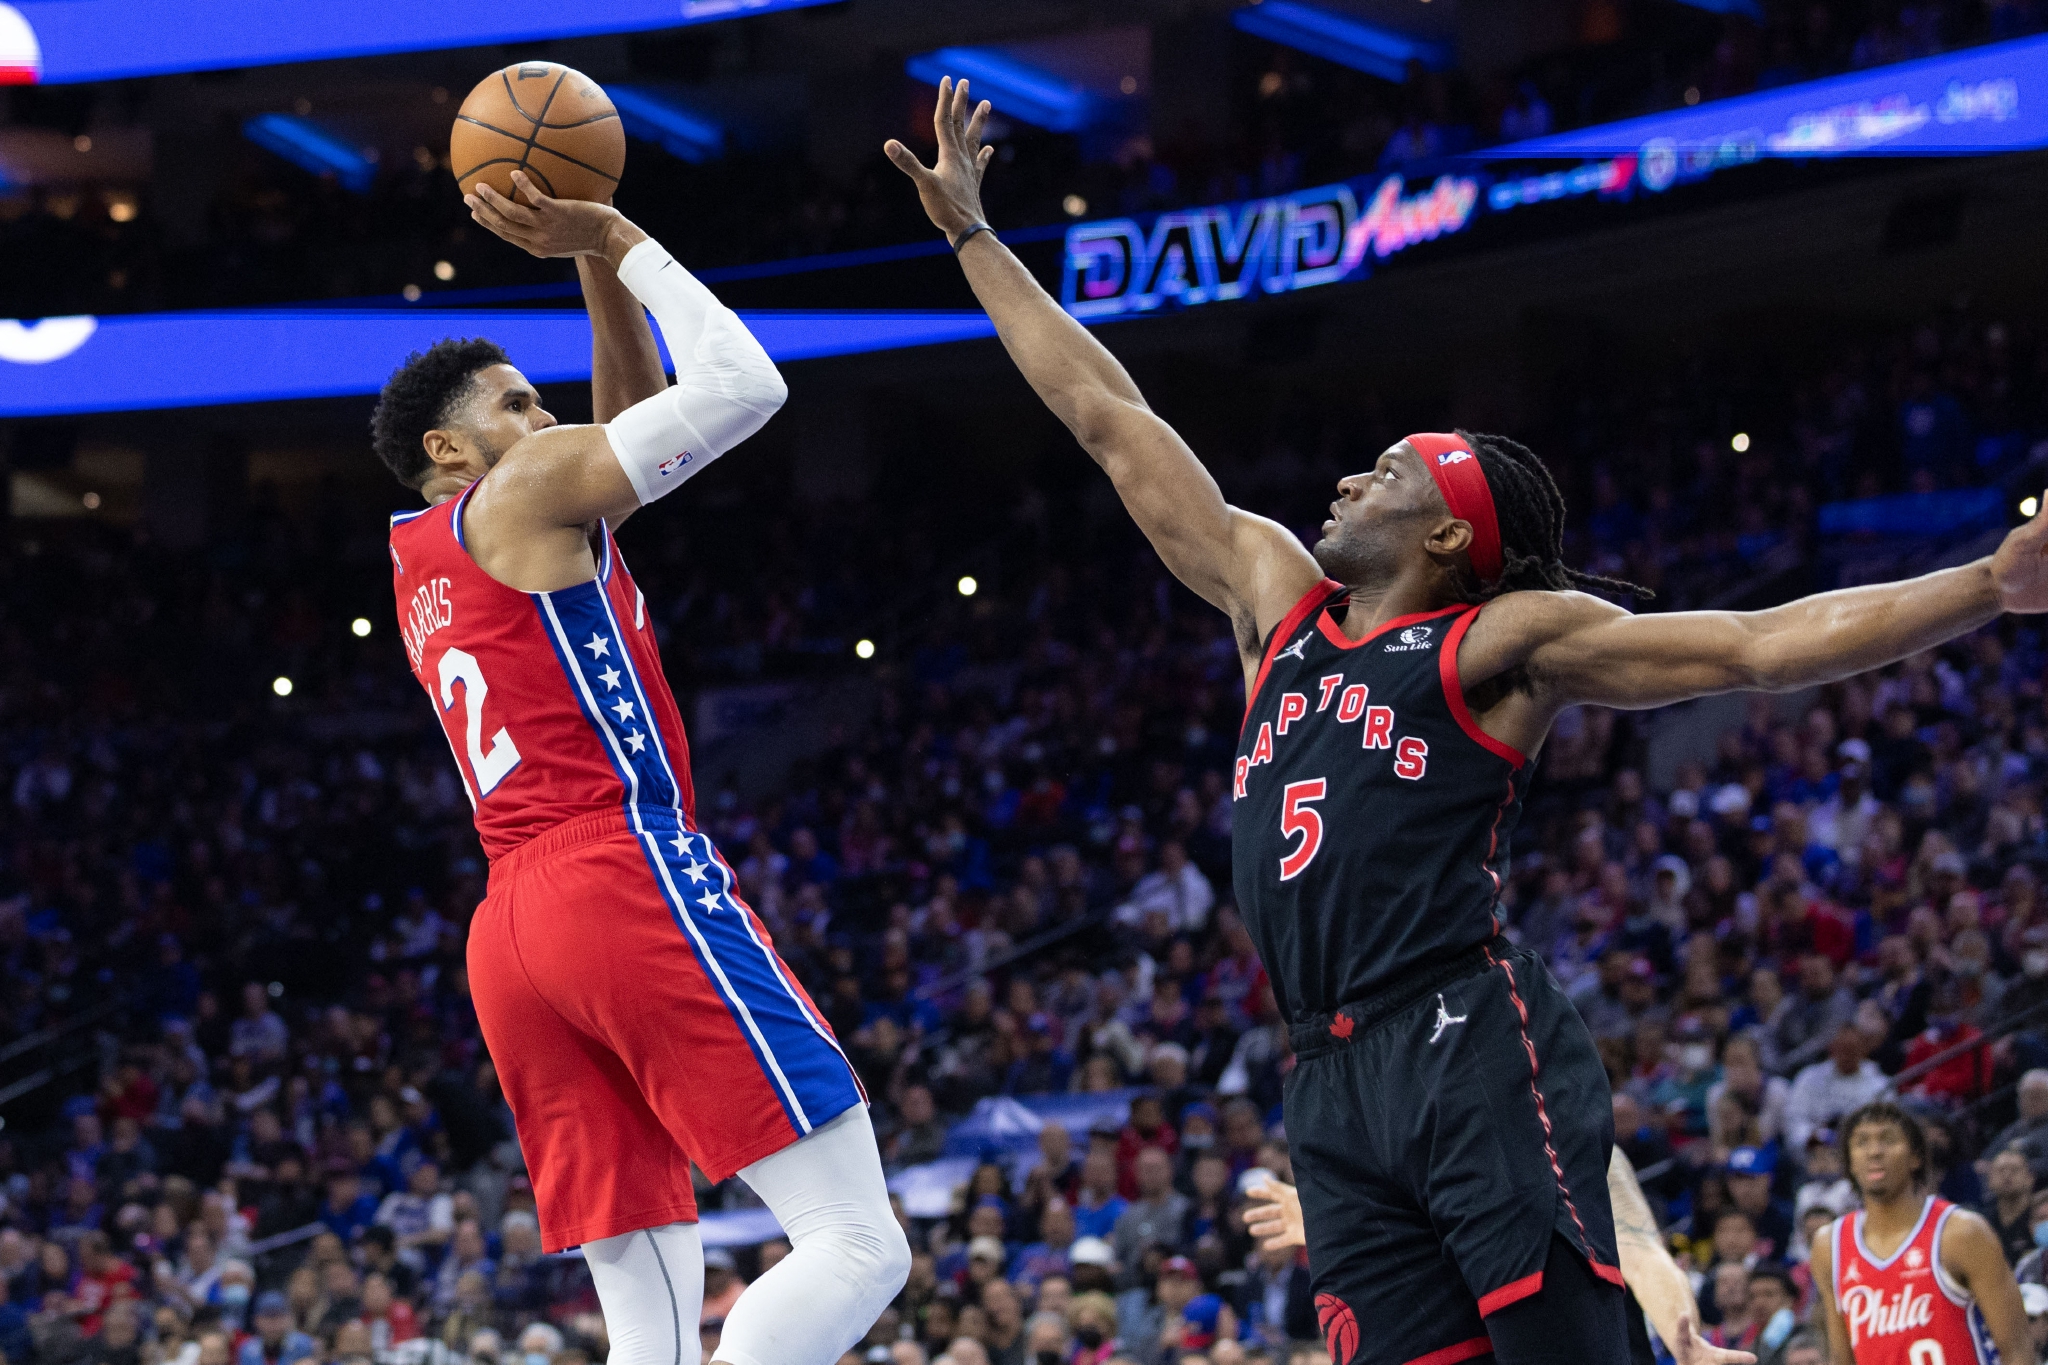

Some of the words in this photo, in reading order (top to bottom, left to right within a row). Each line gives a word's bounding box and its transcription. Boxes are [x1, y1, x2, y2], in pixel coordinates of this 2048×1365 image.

[1063, 185, 1357, 320] DAVID
[1410, 641, 1432, 650] Life
[428, 646, 521, 814] 2
[1234, 673, 1428, 802] RAPTORS
[1280, 777, 1326, 881] 5
[1842, 1284, 1933, 1349] Phila
